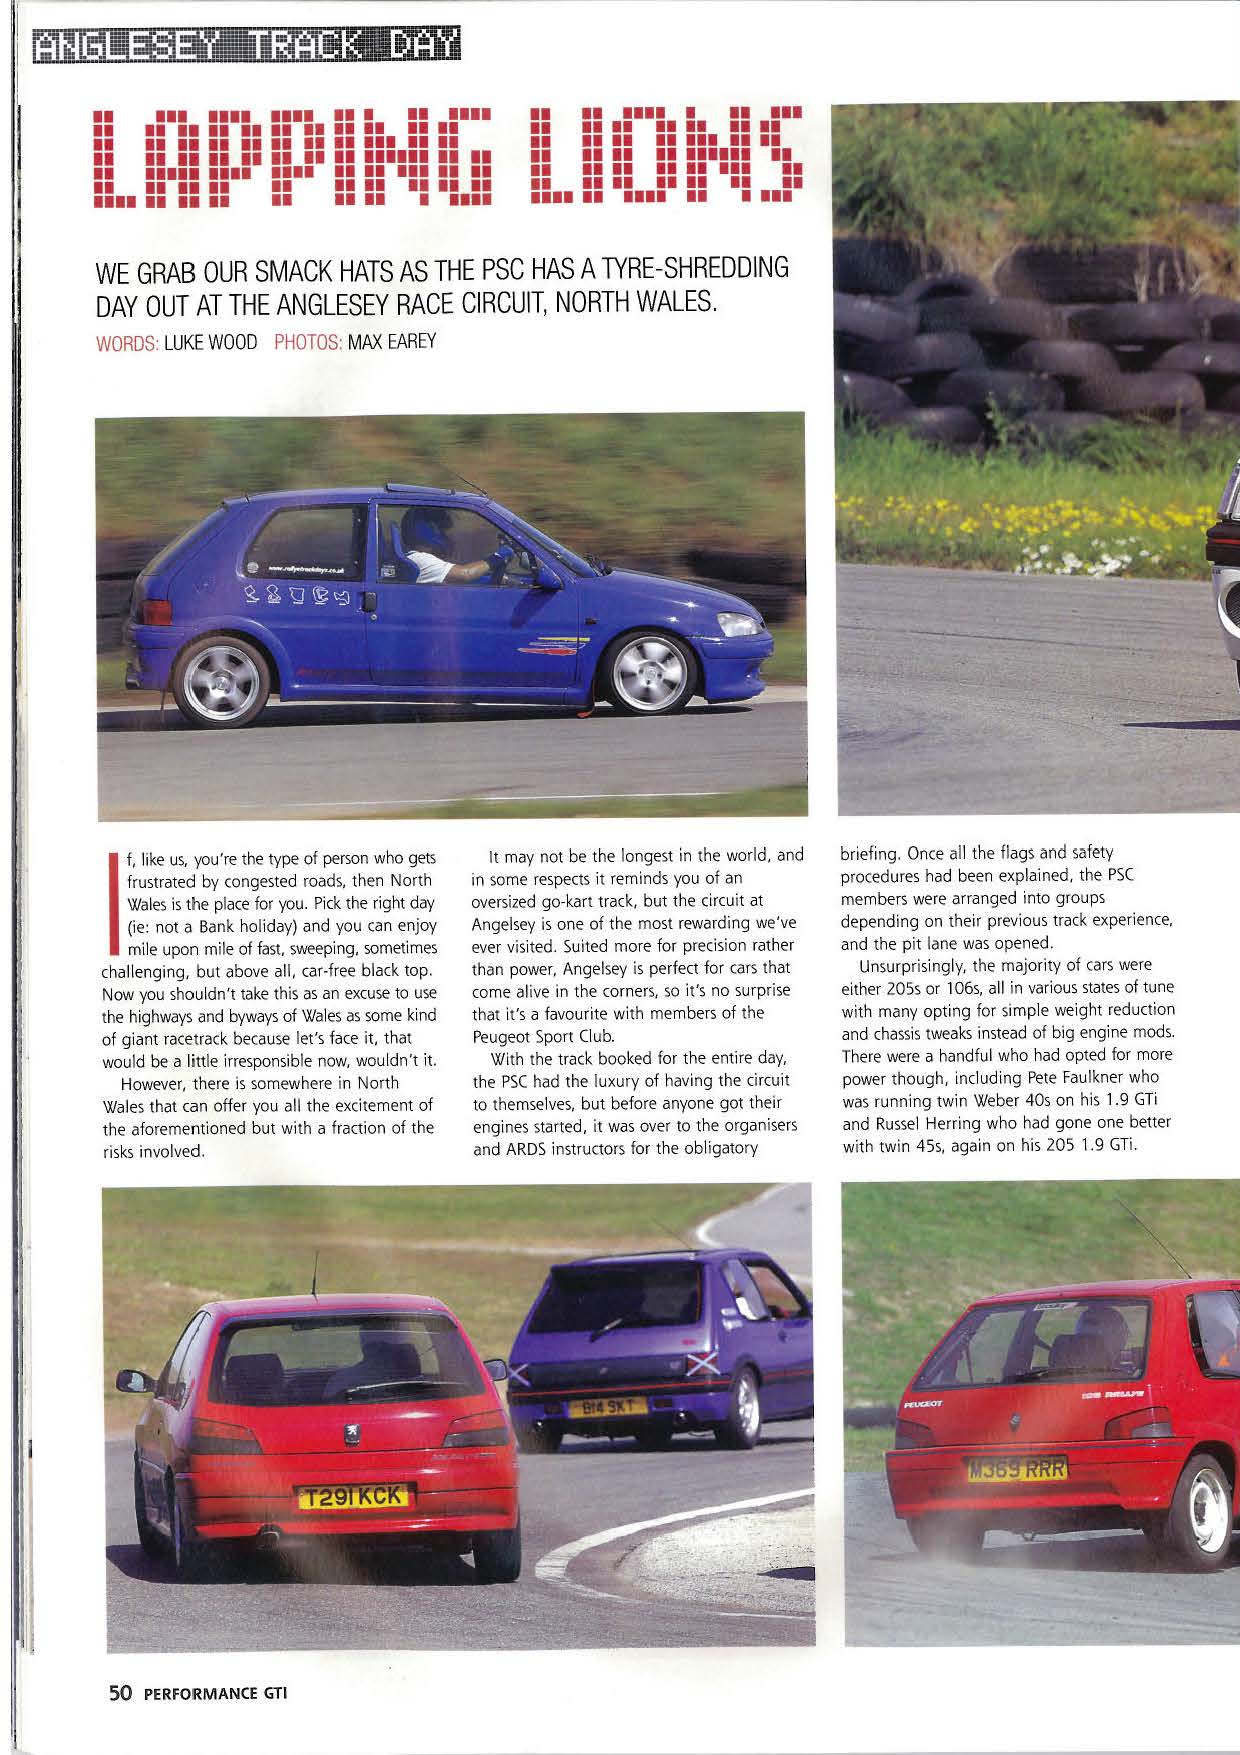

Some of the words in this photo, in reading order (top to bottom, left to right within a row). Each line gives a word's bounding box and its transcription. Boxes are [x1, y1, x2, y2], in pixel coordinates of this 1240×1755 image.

[34, 31, 219, 61] ANGLESEY
[246, 30, 364, 60] TRACK
[388, 28, 459, 57] DAY
[93, 108, 492, 208] LAPPING
[530, 106, 803, 204] LIONS
[95, 262, 130, 285] WE
[137, 261, 196, 285] GRAB
[203, 260, 248, 284] OUR
[255, 259, 333, 283] SMACK
[340, 259, 394, 283] HATS
[399, 259, 429, 283] AS
[433, 258, 475, 282] THE
[482, 257, 525, 281] PSC
[532, 256, 575, 280] HAS
[580, 257, 597, 280] A
[601, 255, 789, 280] TYRE-SHREDDING
[96, 295, 139, 318] DAY
[146, 294, 190, 318] OUT
[196, 293, 223, 317] AT
[228, 293, 271, 316] THE
[276, 292, 390, 317] ANGLESEY
[397, 291, 454, 316] RACE
[461, 290, 548, 316] CIRCUIT,
[556, 289, 630, 314] NORTH
[636, 288, 717, 313] WALES.
[96, 335, 159, 353] WORDS:
[164, 333, 204, 351] LUKE
[208, 333, 258, 351] WOOD
[274, 333, 343, 351] PHOTOS:
[348, 333, 383, 351] MAX
[388, 331, 437, 350] EAREY
[840, 844, 901, 865] briefing.
[907, 845, 945, 861] Once
[949, 844, 966, 861] all
[972, 844, 996, 860] the
[1000, 843, 1035, 864] flags
[1039, 843, 1067, 860] and
[1072, 843, 1114, 863] safety
[127, 873, 196, 889] frustrated
[202, 873, 220, 892] by
[224, 873, 297, 892] congested
[303, 873, 346, 889] roads,
[351, 872, 384, 888] then
[390, 872, 432, 887] North
[127, 896, 167, 912] Wales
[171, 896, 182, 912] is
[185, 896, 210, 911] the
[214, 896, 250, 915] place
[254, 895, 274, 911] for
[278, 899, 308, 914] you.
[314, 895, 342, 910] Pick
[345, 895, 369, 910] the
[372, 894, 406, 914] right
[409, 894, 435, 913] day
[471, 893, 536, 909] oversized
[541, 893, 594, 912] go-kart
[597, 893, 638, 910] track,
[643, 892, 668, 908] but
[672, 892, 696, 908] the
[701, 892, 745, 908] circuit
[749, 894, 764, 907] at
[101, 964, 190, 983] challenging,
[196, 963, 221, 979] but
[225, 963, 269, 979] above
[274, 963, 296, 980] all,
[301, 962, 356, 978] car-free
[361, 962, 400, 978] black
[404, 964, 433, 981] top.
[473, 1029, 531, 1048] Peugeot
[535, 1029, 574, 1047] Sport
[579, 1028, 615, 1043] Club.
[473, 1141, 501, 1157] and
[505, 1141, 546, 1156] ARDS
[551, 1141, 626, 1156] instructors
[630, 1140, 651, 1155] for
[656, 1140, 680, 1155] the
[684, 1139, 759, 1159] obligatory
[842, 1138, 874, 1154] with
[878, 1138, 910, 1153] twin
[916, 1138, 945, 1155] 45s,
[951, 1137, 991, 1156] again
[996, 1141, 1015, 1153] on
[1021, 1137, 1041, 1152] his
[1046, 1137, 1075, 1152] 205
[1082, 1137, 1105, 1152] 1.9
[1109, 1136, 1138, 1152] GTi.
[904, 1400, 943, 1409] PEUGEOT
[1025, 1457, 1064, 1479] RRR
[307, 1488, 353, 1507] T291
[359, 1485, 401, 1505] KCK
[109, 1684, 133, 1702] 50
[144, 1686, 258, 1701] PERFORMANCE
[263, 1686, 288, 1700] GTI
